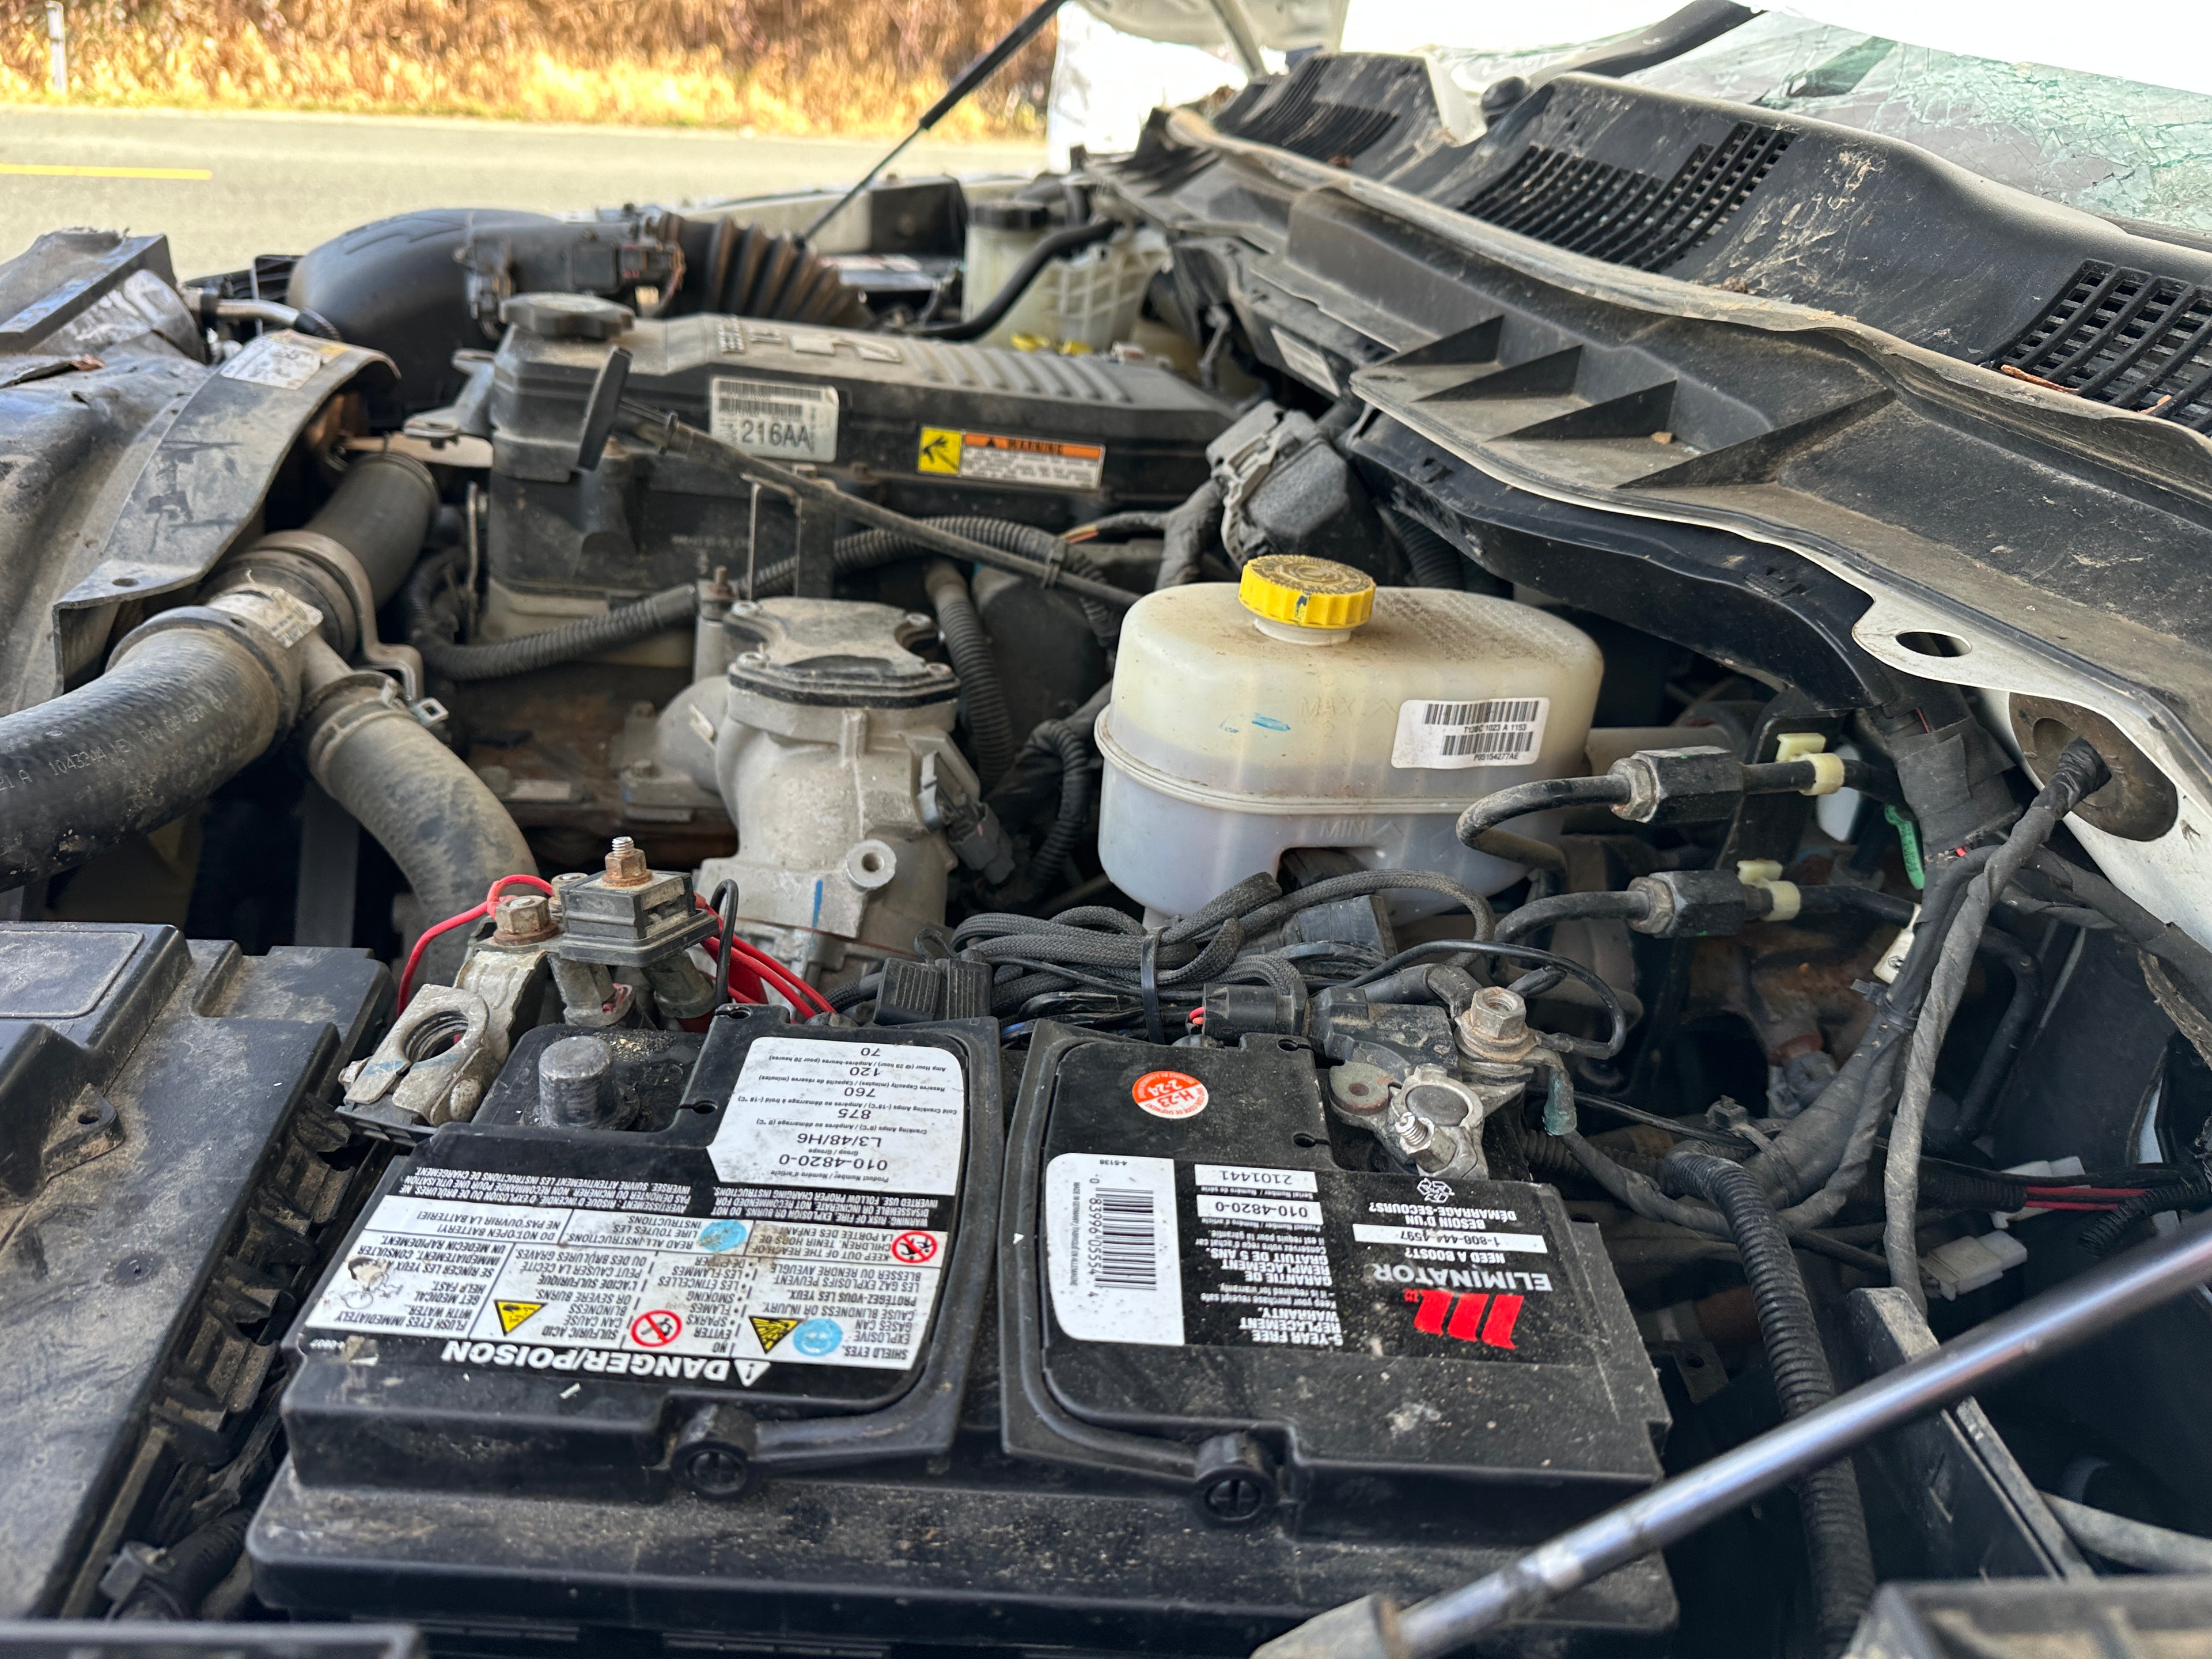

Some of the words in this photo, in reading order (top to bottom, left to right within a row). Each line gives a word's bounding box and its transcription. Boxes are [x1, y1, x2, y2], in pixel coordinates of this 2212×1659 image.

[861, 1047, 881, 1056] 70
[850, 1067, 880, 1077] 120
[844, 1087, 876, 1097] 760
[1147, 1079, 1183, 1096] 2-24
[1157, 1090, 1195, 1107] H-23
[838, 1108, 871, 1119] 875
[796, 1133, 882, 1147] L3/48/H6
[779, 1154, 888, 1171] 010-4820-0
[1219, 1170, 1292, 1185] 2101441
[1215, 1202, 1308, 1218] 010-4820-0
[1369, 1202, 1516, 1221] DÉMARRAGE-SECOURS?
[416, 1210, 469, 1222] BATTERIE!
[469, 1215, 483, 1224] LA
[1088, 1198, 1102, 1234] 83996
[1405, 1215, 1436, 1226] D'UN
[485, 1216, 524, 1228] OUVRIR
[525, 1218, 542, 1229] PAS
[545, 1220, 561, 1229] NE
[626, 1215, 702, 1229] INSTRUCTIONS.
[1438, 1217, 1486, 1230] BESOIN
[437, 1224, 484, 1236] BATTERY!
[487, 1228, 515, 1238] OPEN
[518, 1230, 538, 1240] NOT
[632, 1226, 671, 1237] TOUTES
[676, 1229, 698, 1238] LIRE
[820, 1229, 839, 1238] DES
[381, 1234, 444, 1249] RAPIDEMENT.
[540, 1232, 555, 1241] DO
[566, 1233, 641, 1246] INSTRUCTIONS.
[842, 1230, 875, 1243] PORTÉE
[878, 1233, 893, 1242] LA
[645, 1238, 664, 1248] ALL
[668, 1240, 694, 1249] READ
[806, 1237, 835, 1248] TENIR
[839, 1240, 891, 1252] CHILDREN.
[357, 1245, 414, 1259] CONSULTER
[492, 1244, 506, 1253] UN
[514, 1248, 555, 1260] GRAVES.
[751, 1245, 765, 1253] OF
[804, 1248, 822, 1257] THE
[826, 1250, 839, 1258] OF
[1205, 1247, 1236, 1259] ANS.
[1404, 1247, 1455, 1260] BOOST?
[558, 1251, 609, 1264] BRÛLURES
[612, 1255, 630, 1264] DES
[842, 1251, 860, 1260] OUT
[864, 1252, 888, 1261] KEEP
[1088, 1239, 1103, 1275] 05554
[1240, 1250, 1249, 1260] 5
[1251, 1251, 1270, 1262] DE
[1273, 1252, 1328, 1265] GRATUIT
[1457, 1251, 1467, 1262] A
[1470, 1252, 1505, 1264] NEED
[632, 1256, 647, 1266] OU
[395, 1262, 421, 1272] YEUX
[423, 1263, 439, 1274] LES
[481, 1267, 494, 1278] SE
[519, 1262, 555, 1274] CÉCITÉ
[558, 1264, 569, 1273] LA
[573, 1264, 614, 1276] CAUSER
[617, 1267, 642, 1278] PEUT
[672, 1266, 722, 1278] FLAMMES
[819, 1266, 857, 1278] RENDRE
[1221, 1259, 1330, 1275] REMPLACEMENT
[724, 1269, 743, 1279] LES
[861, 1268, 875, 1279] OU
[878, 1269, 921, 1281] BLESSER
[1244, 1271, 1262, 1282] DE
[1371, 1263, 1553, 1291] ELIMINATOR
[537, 1274, 597, 1287] SULFURIQUE
[600, 1279, 638, 1290] L'ACIDE
[658, 1276, 717, 1291] ÉTINCELLES
[721, 1280, 740, 1290] LES
[774, 1274, 820, 1286] PEUVENT
[823, 1277, 876, 1290] EXPLOSIFS
[1265, 1273, 1332, 1287] GARANTIE
[431, 1281, 457, 1291] FAST.
[459, 1282, 486, 1294] HELP
[879, 1281, 898, 1291] GAZ
[901, 1282, 919, 1292] LES
[414, 1291, 454, 1304] MEDICAL
[455, 1294, 481, 1305] GET
[535, 1289, 573, 1300] BURNS.
[577, 1291, 613, 1302] SEVERE
[617, 1294, 631, 1304] OR
[687, 1291, 735, 1302] SMOKING
[787, 1289, 816, 1301] YEUX.
[819, 1291, 836, 1302] LES
[838, 1292, 916, 1308] PROTÉGEZ-VOUS
[406, 1305, 441, 1317] WATER.
[441, 1308, 472, 1319] WITH
[569, 1303, 628, 1316] BLINDNESS
[691, 1303, 732, 1313] FLAMES
[763, 1302, 801, 1314] INJURY.
[804, 1305, 818, 1315] OR
[822, 1306, 878, 1318] BLINDNESS
[334, 1311, 406, 1326] IMMEDIATELY
[880, 1308, 915, 1320] CAUSE
[408, 1317, 431, 1327] EYES
[434, 1319, 468, 1331] FLUSH
[563, 1315, 600, 1326] CAUSE
[603, 1317, 623, 1327] CAN
[686, 1315, 728, 1326] SPARKS
[855, 1320, 876, 1330] CAN
[880, 1320, 912, 1332] GASES
[1238, 1317, 1342, 1334] REPLACEMENT
[541, 1325, 566, 1336] ACID
[569, 1327, 619, 1340] SULFURIC
[694, 1327, 732, 1340] ÉVITER
[855, 1331, 910, 1344] EXPLOSIVE
[1251, 1330, 1288, 1343] FREE
[1290, 1332, 1343, 1347] 5-YEAR
[713, 1342, 728, 1353] NO
[842, 1345, 870, 1357] EYES.
[873, 1347, 908, 1359] SHIELD
[440, 1340, 730, 1381] DANGER/POISON
